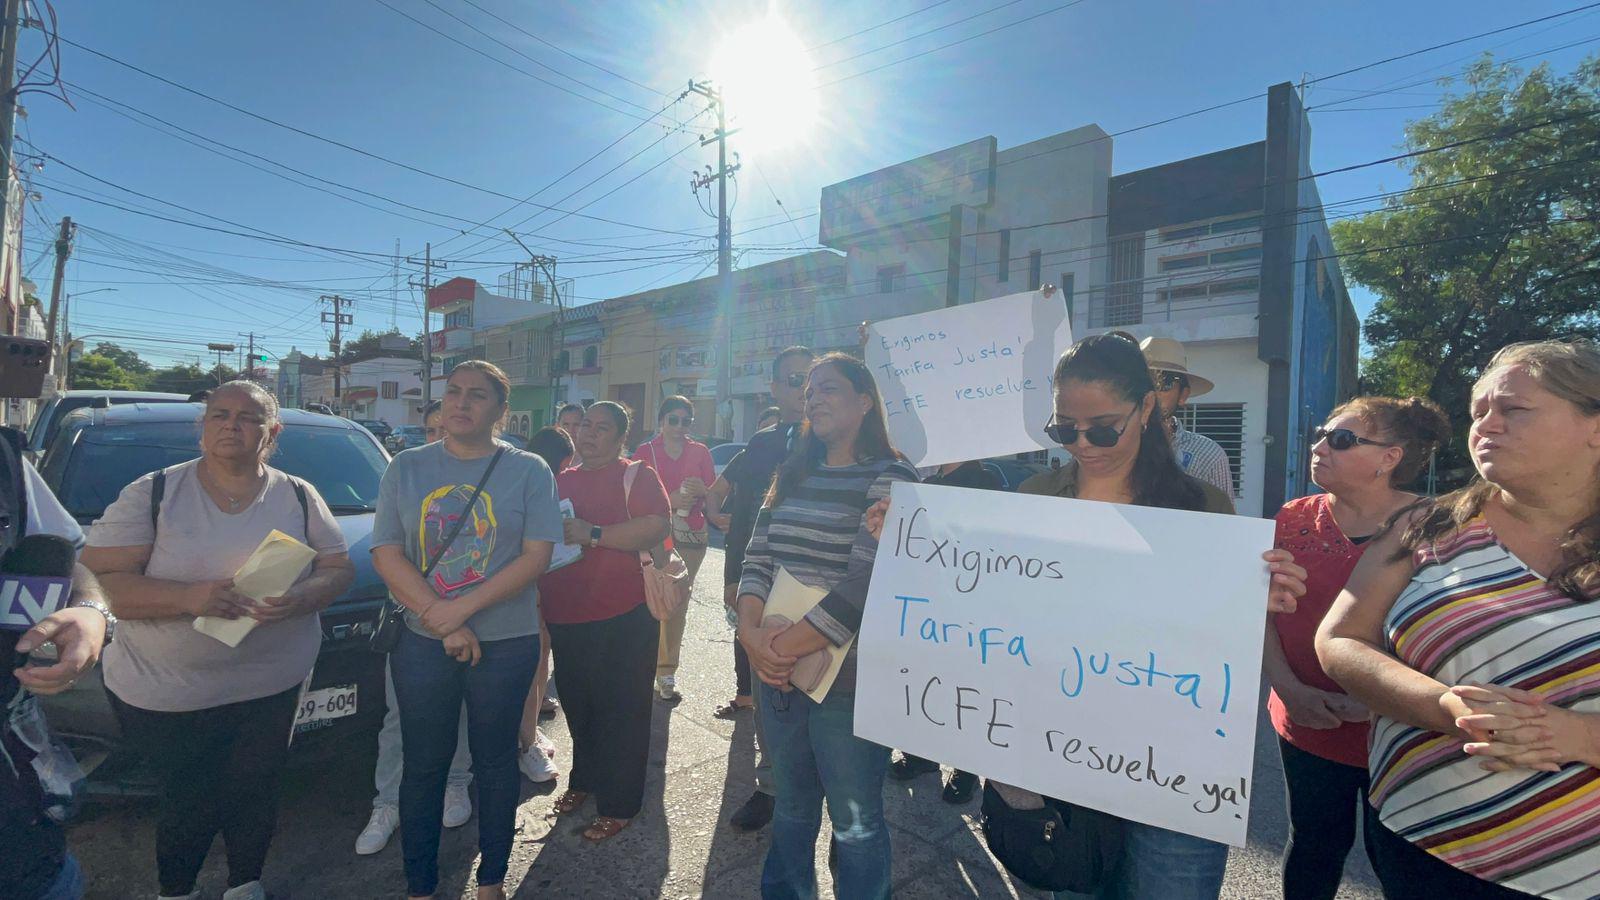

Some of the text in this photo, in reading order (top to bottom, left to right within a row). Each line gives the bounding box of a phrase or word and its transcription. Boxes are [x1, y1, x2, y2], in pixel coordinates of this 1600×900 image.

[955, 376, 1038, 401] resuelve
[1045, 730, 1189, 795] resuelve
[1193, 777, 1248, 820] ya!
